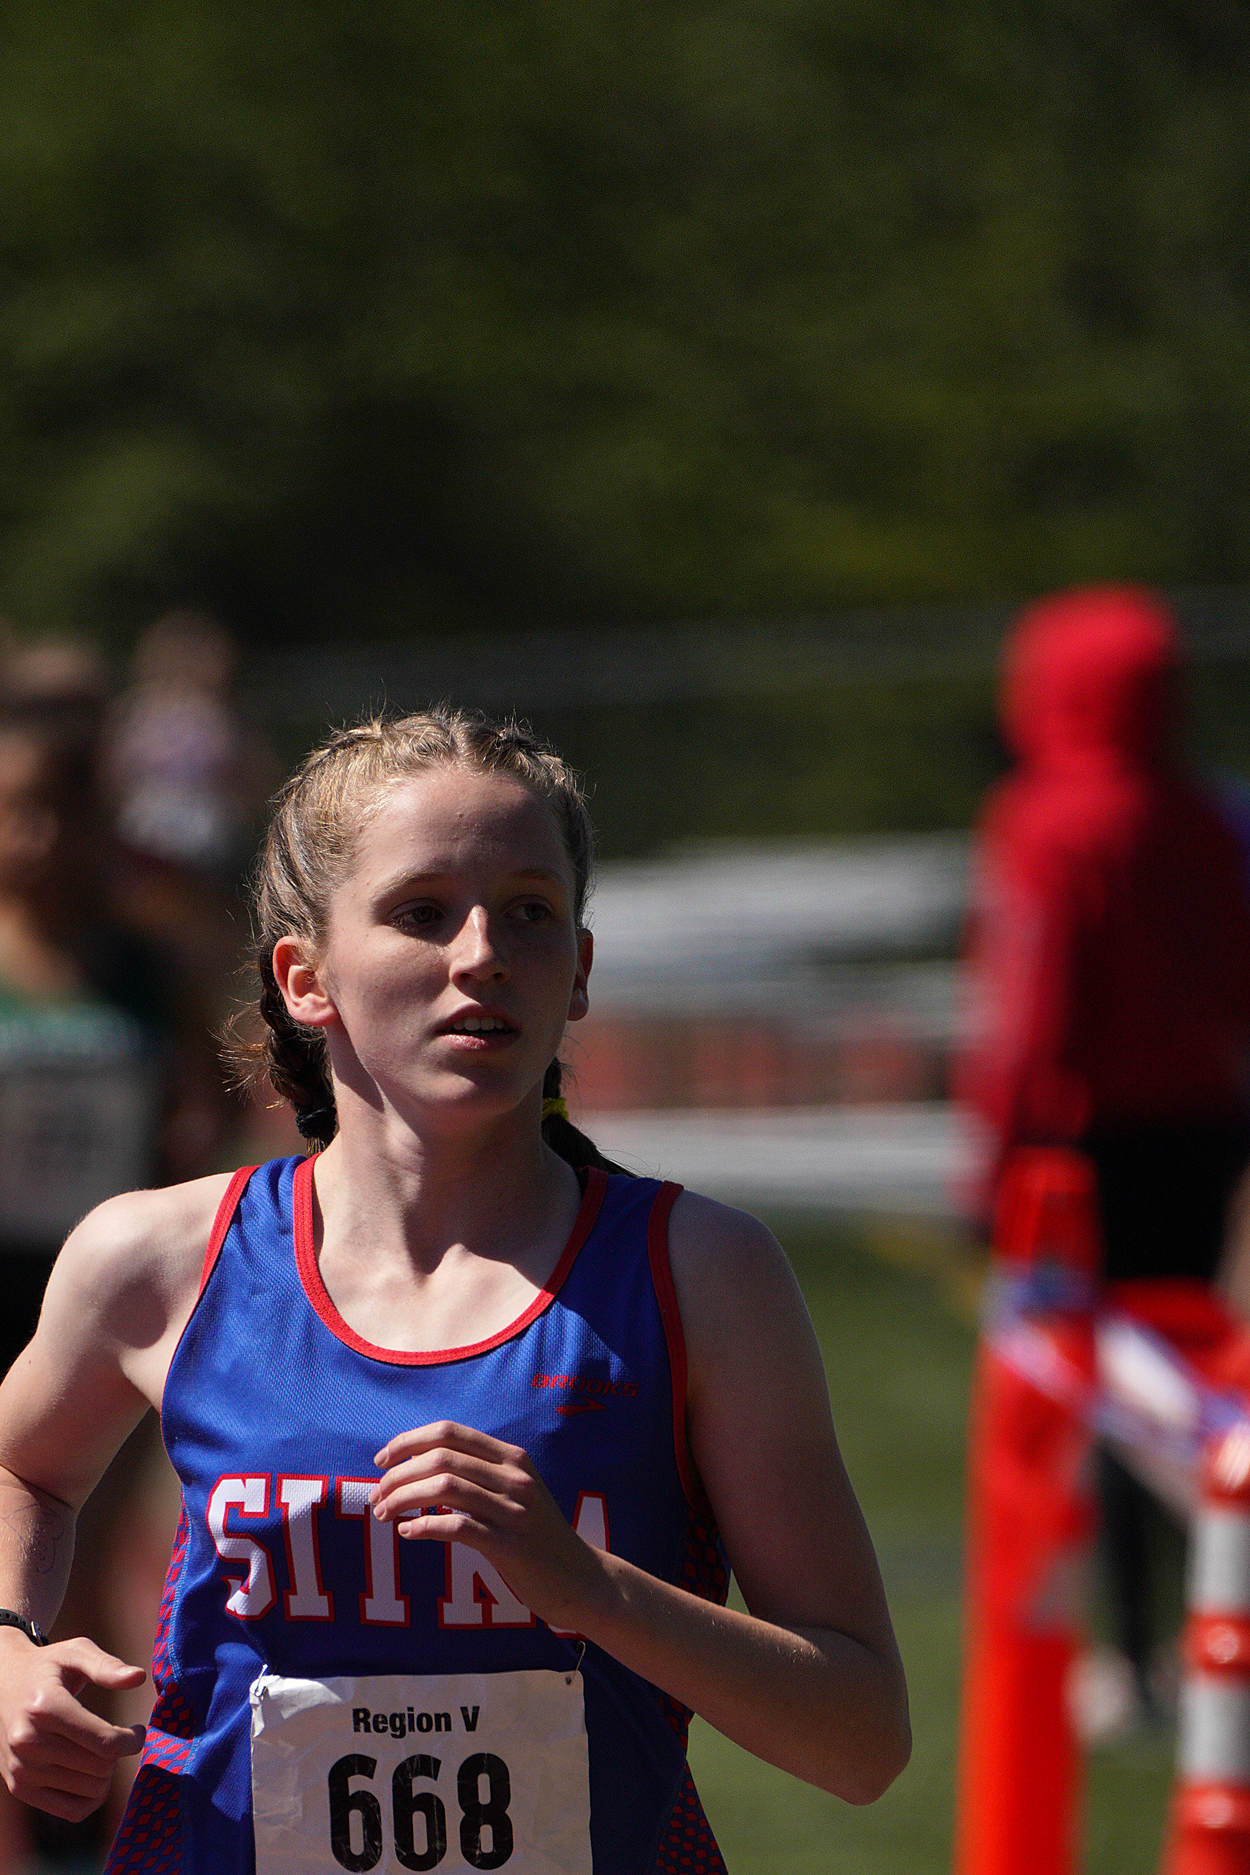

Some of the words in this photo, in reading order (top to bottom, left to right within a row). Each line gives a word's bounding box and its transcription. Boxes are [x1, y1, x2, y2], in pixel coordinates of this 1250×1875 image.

[531, 1374, 640, 1398] BROOKS
[206, 1472, 611, 1641] SITK
[352, 1706, 453, 1739] Region
[460, 1705, 481, 1732] V
[328, 1752, 514, 1873] 668
